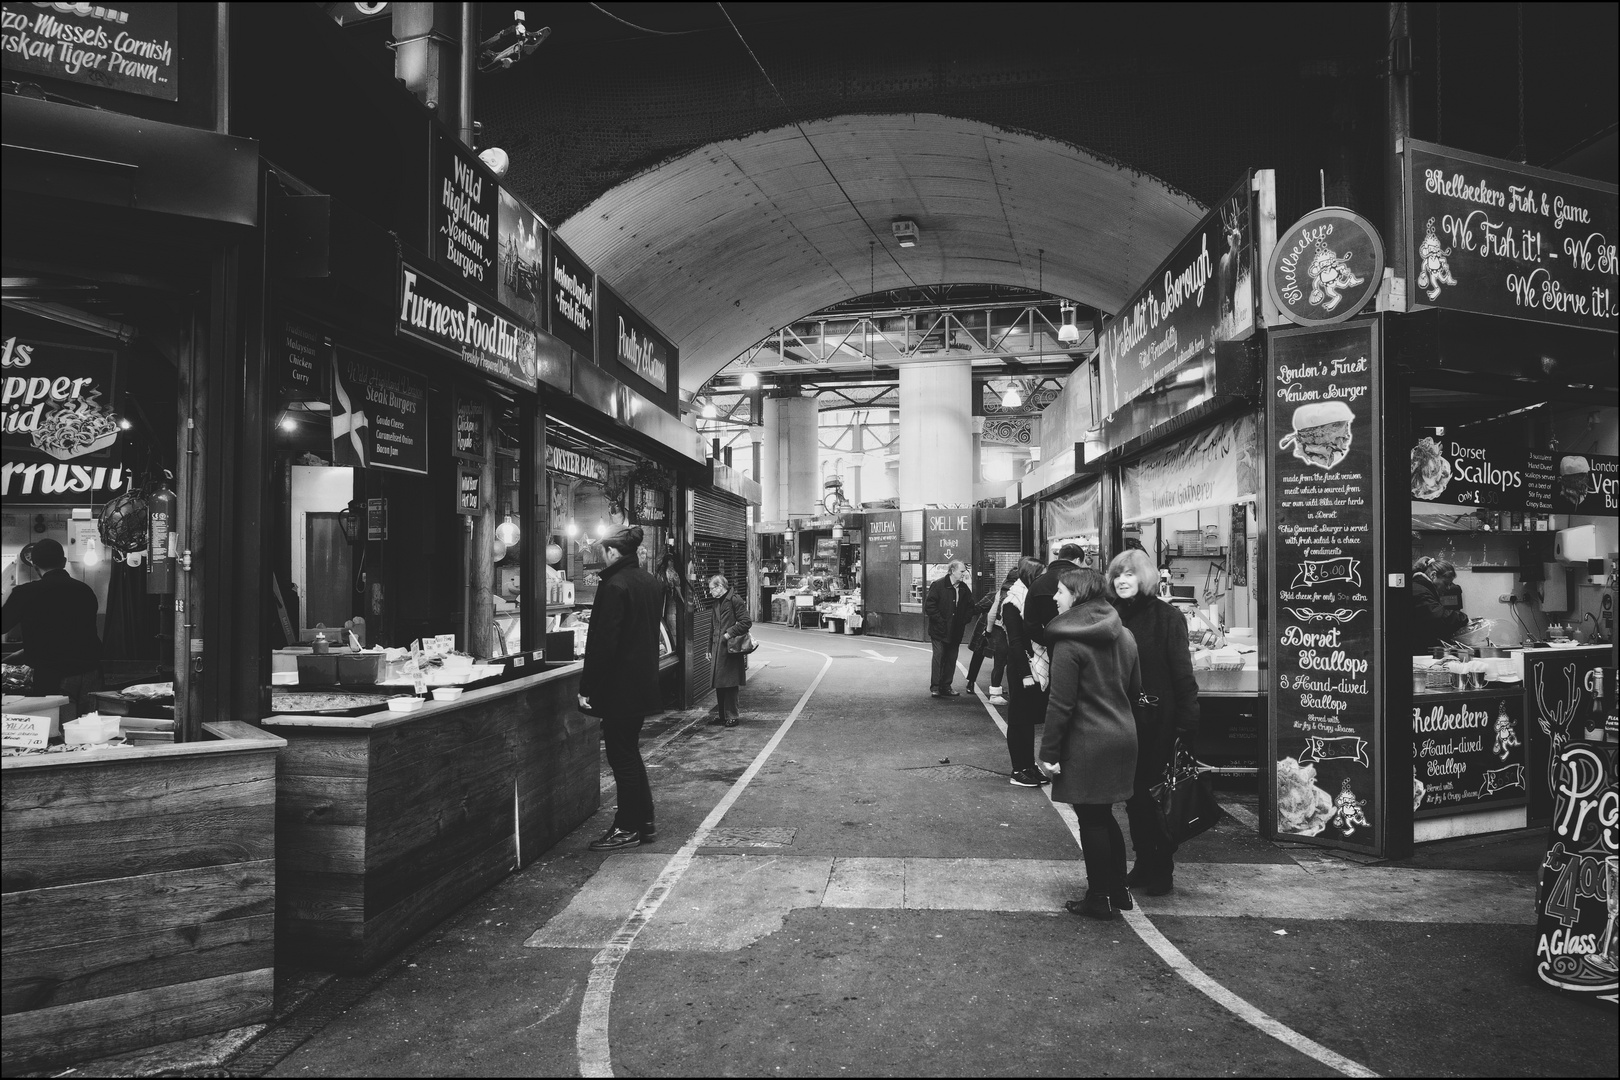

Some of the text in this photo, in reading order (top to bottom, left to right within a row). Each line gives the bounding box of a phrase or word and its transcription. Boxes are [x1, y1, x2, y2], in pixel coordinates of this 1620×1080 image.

[34, 12, 109, 49] Mussels
[114, 31, 172, 66] Cornish
[57, 40, 107, 75] Tiger
[454, 154, 482, 204] Wild
[442, 177, 489, 240] Highland
[1425, 168, 1591, 229] Shellseekers Fish & Game
[447, 214, 483, 260] Venison
[1442, 209, 1488, 251] We
[1480, 221, 1521, 258] Fish
[1522, 229, 1541, 263] it!
[1563, 232, 1606, 271] We
[446, 237, 484, 282] Burgers
[1279, 223, 1335, 306] Shellseekers
[1121, 298, 1148, 358] Bullet
[1147, 290, 1159, 329] to
[1160, 232, 1213, 320] Borough
[1507, 267, 1551, 308] We
[1541, 280, 1590, 315] Serve
[400, 269, 519, 363] Furness Food Hut
[559, 289, 587, 331] Fresh Fish
[462, 345, 480, 368] Freshly
[618, 314, 643, 373] Poultry
[289, 353, 313, 370] Chicken
[292, 369, 310, 386] Curry
[1276, 356, 1368, 385] London's Finest
[366, 384, 417, 415] Steak Burgers
[1276, 382, 1368, 403] Venison Burger
[553, 446, 596, 479] OYSTER BAR
[1450, 441, 1487, 461] Dorset
[1453, 457, 1522, 492] Scallops
[929, 515, 968, 531] SMELL ME
[1314, 510, 1337, 519] Dorset
[1280, 625, 1342, 648] Dorset
[1298, 648, 1369, 681] Scallops
[1292, 675, 1370, 695] Hand-dived
[1300, 692, 1348, 715] Scallops
[1419, 735, 1484, 758] Hand-dived
[1426, 757, 1467, 779] Scallops
[1551, 928, 1597, 956] Glass
